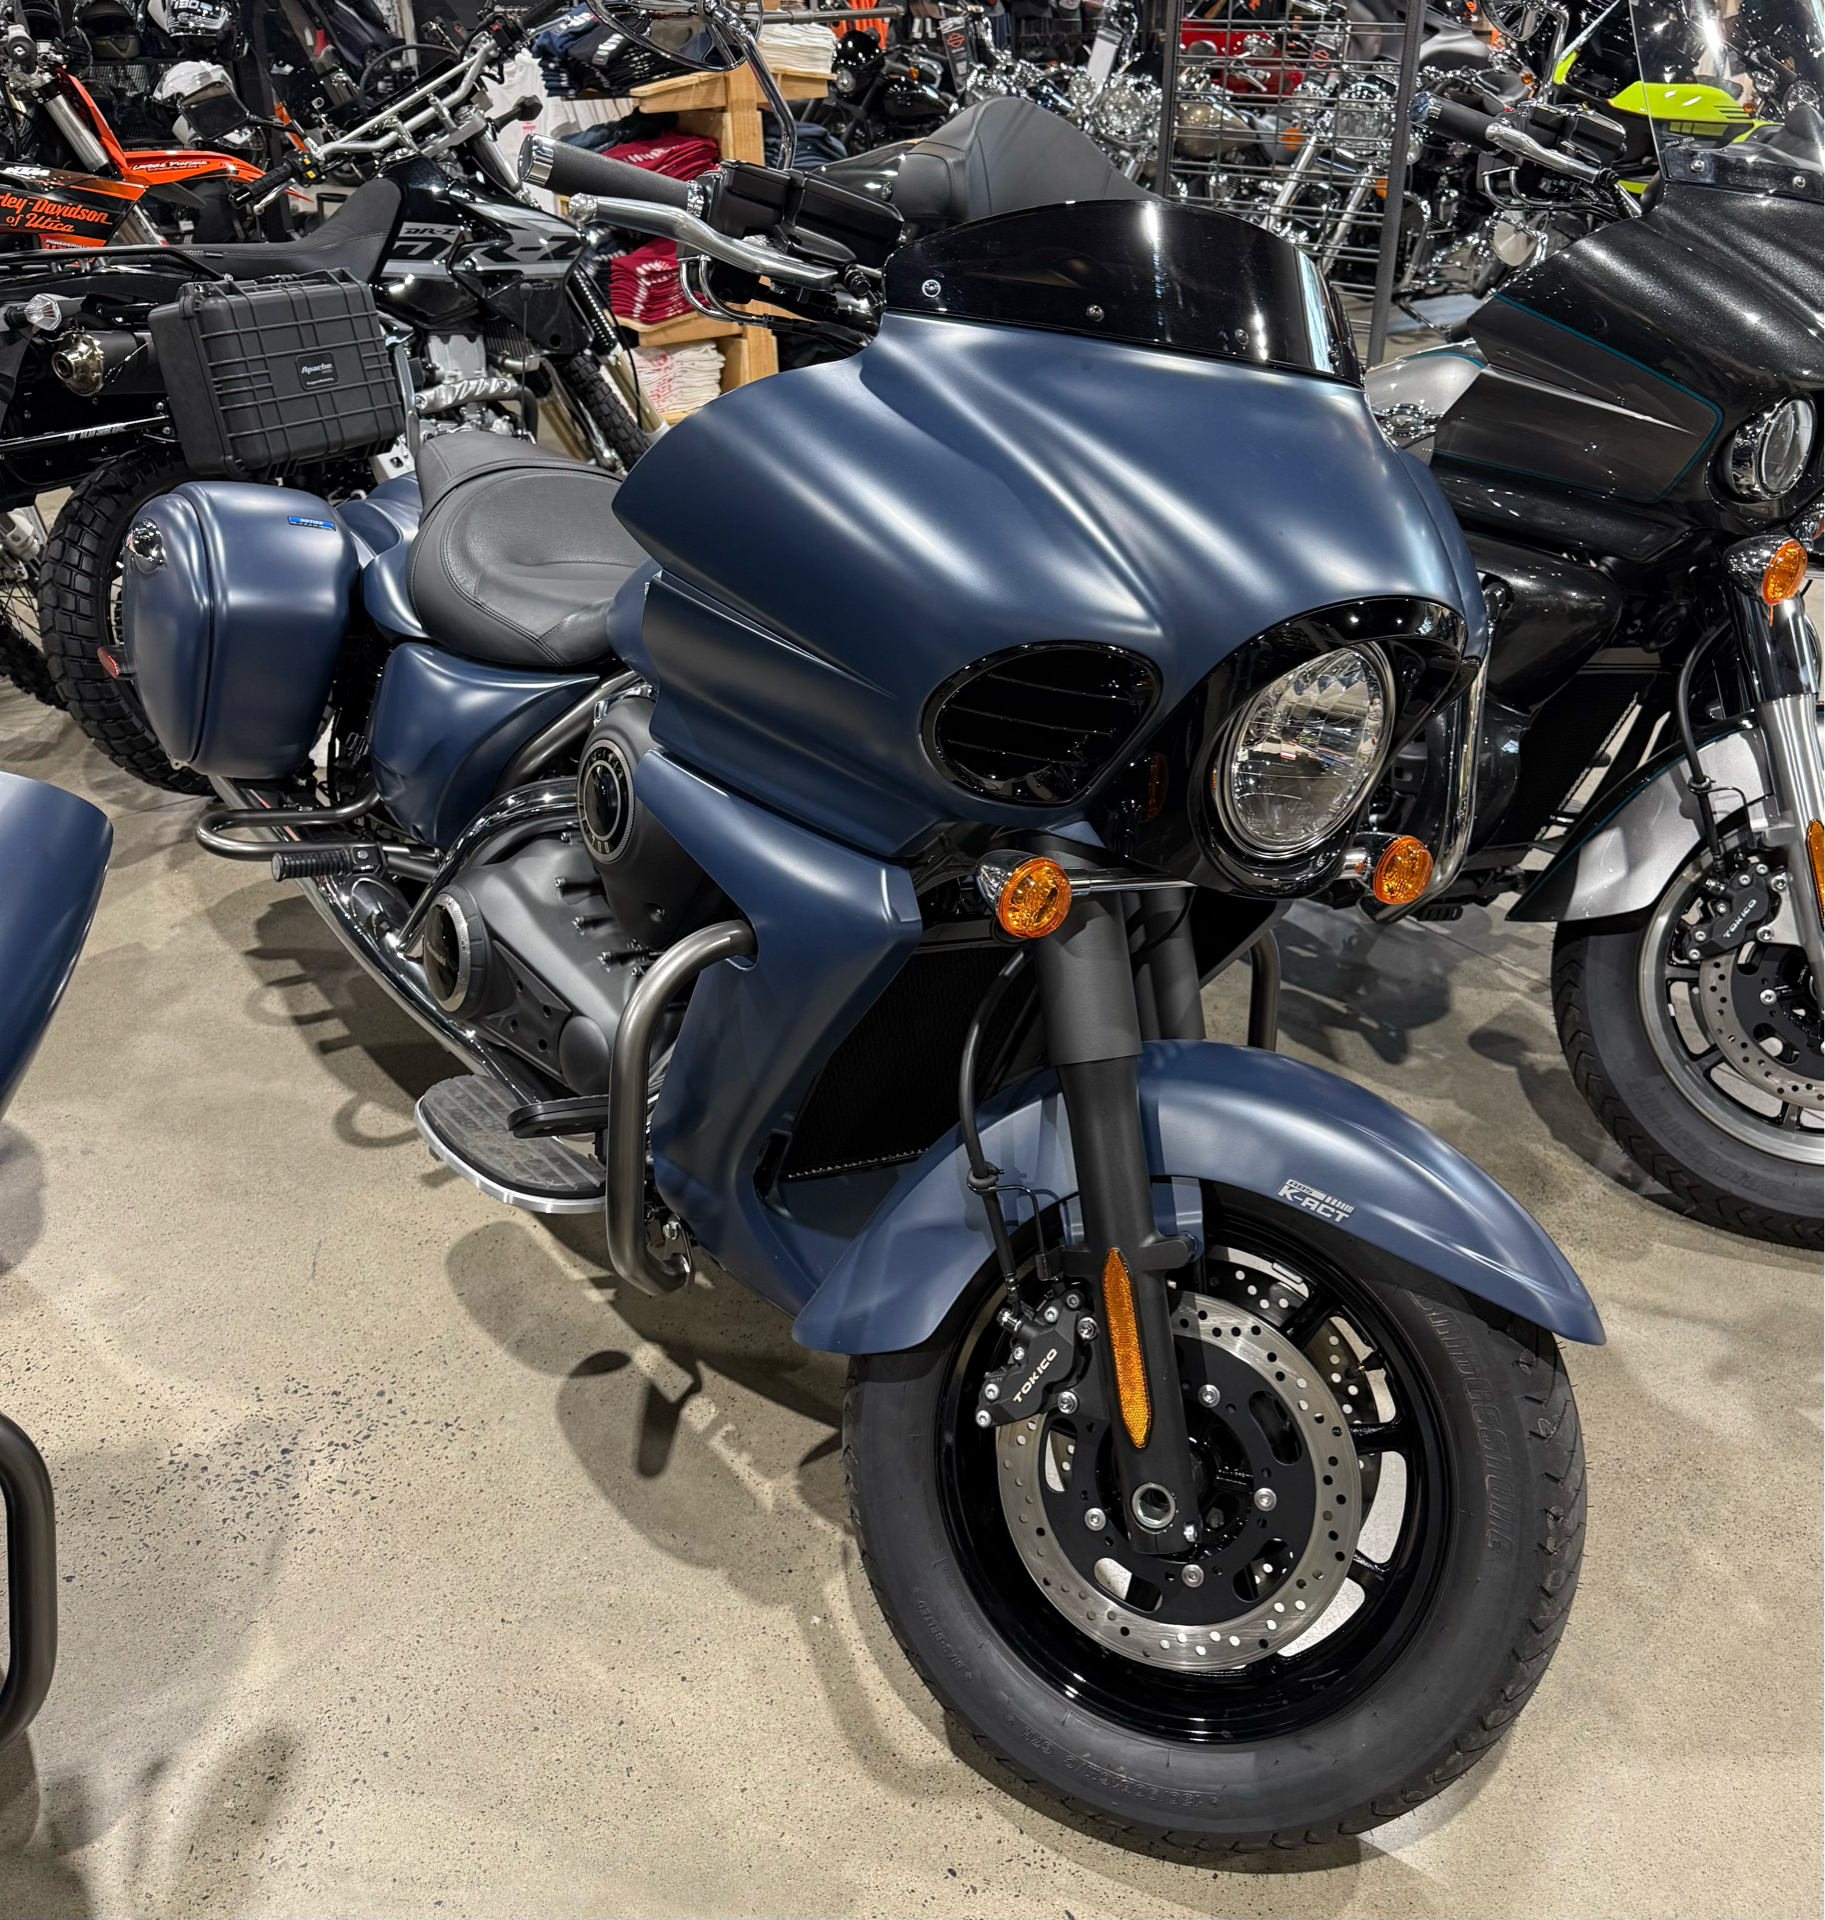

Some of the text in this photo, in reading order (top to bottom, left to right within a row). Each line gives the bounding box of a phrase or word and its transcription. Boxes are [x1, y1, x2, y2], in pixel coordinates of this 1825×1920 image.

[6, 212, 75, 233] of Utica
[404, 227, 456, 236] DR-Z
[301, 363, 333, 375] Apache
[1723, 899, 1757, 938] TOKICO
[1278, 1184, 1349, 1223] K-ACT
[1013, 1348, 1058, 1403] TOKICO
